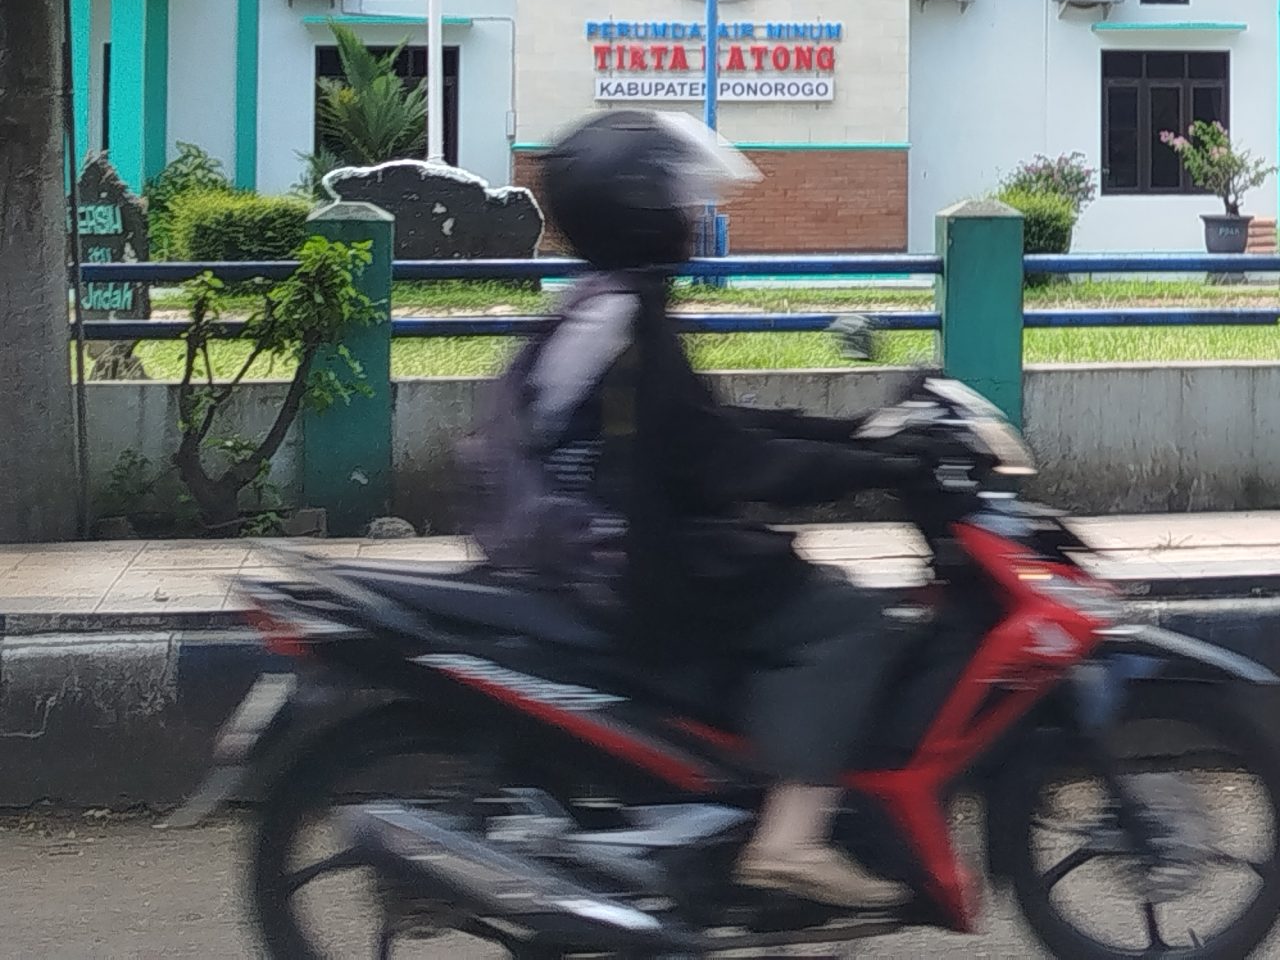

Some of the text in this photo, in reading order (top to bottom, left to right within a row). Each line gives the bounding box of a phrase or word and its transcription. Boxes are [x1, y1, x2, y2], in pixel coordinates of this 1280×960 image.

[586, 22, 842, 40] PERUMDA AIR MINUM
[593, 44, 689, 71] TIRTA
[719, 82, 829, 97] PONOROGO
